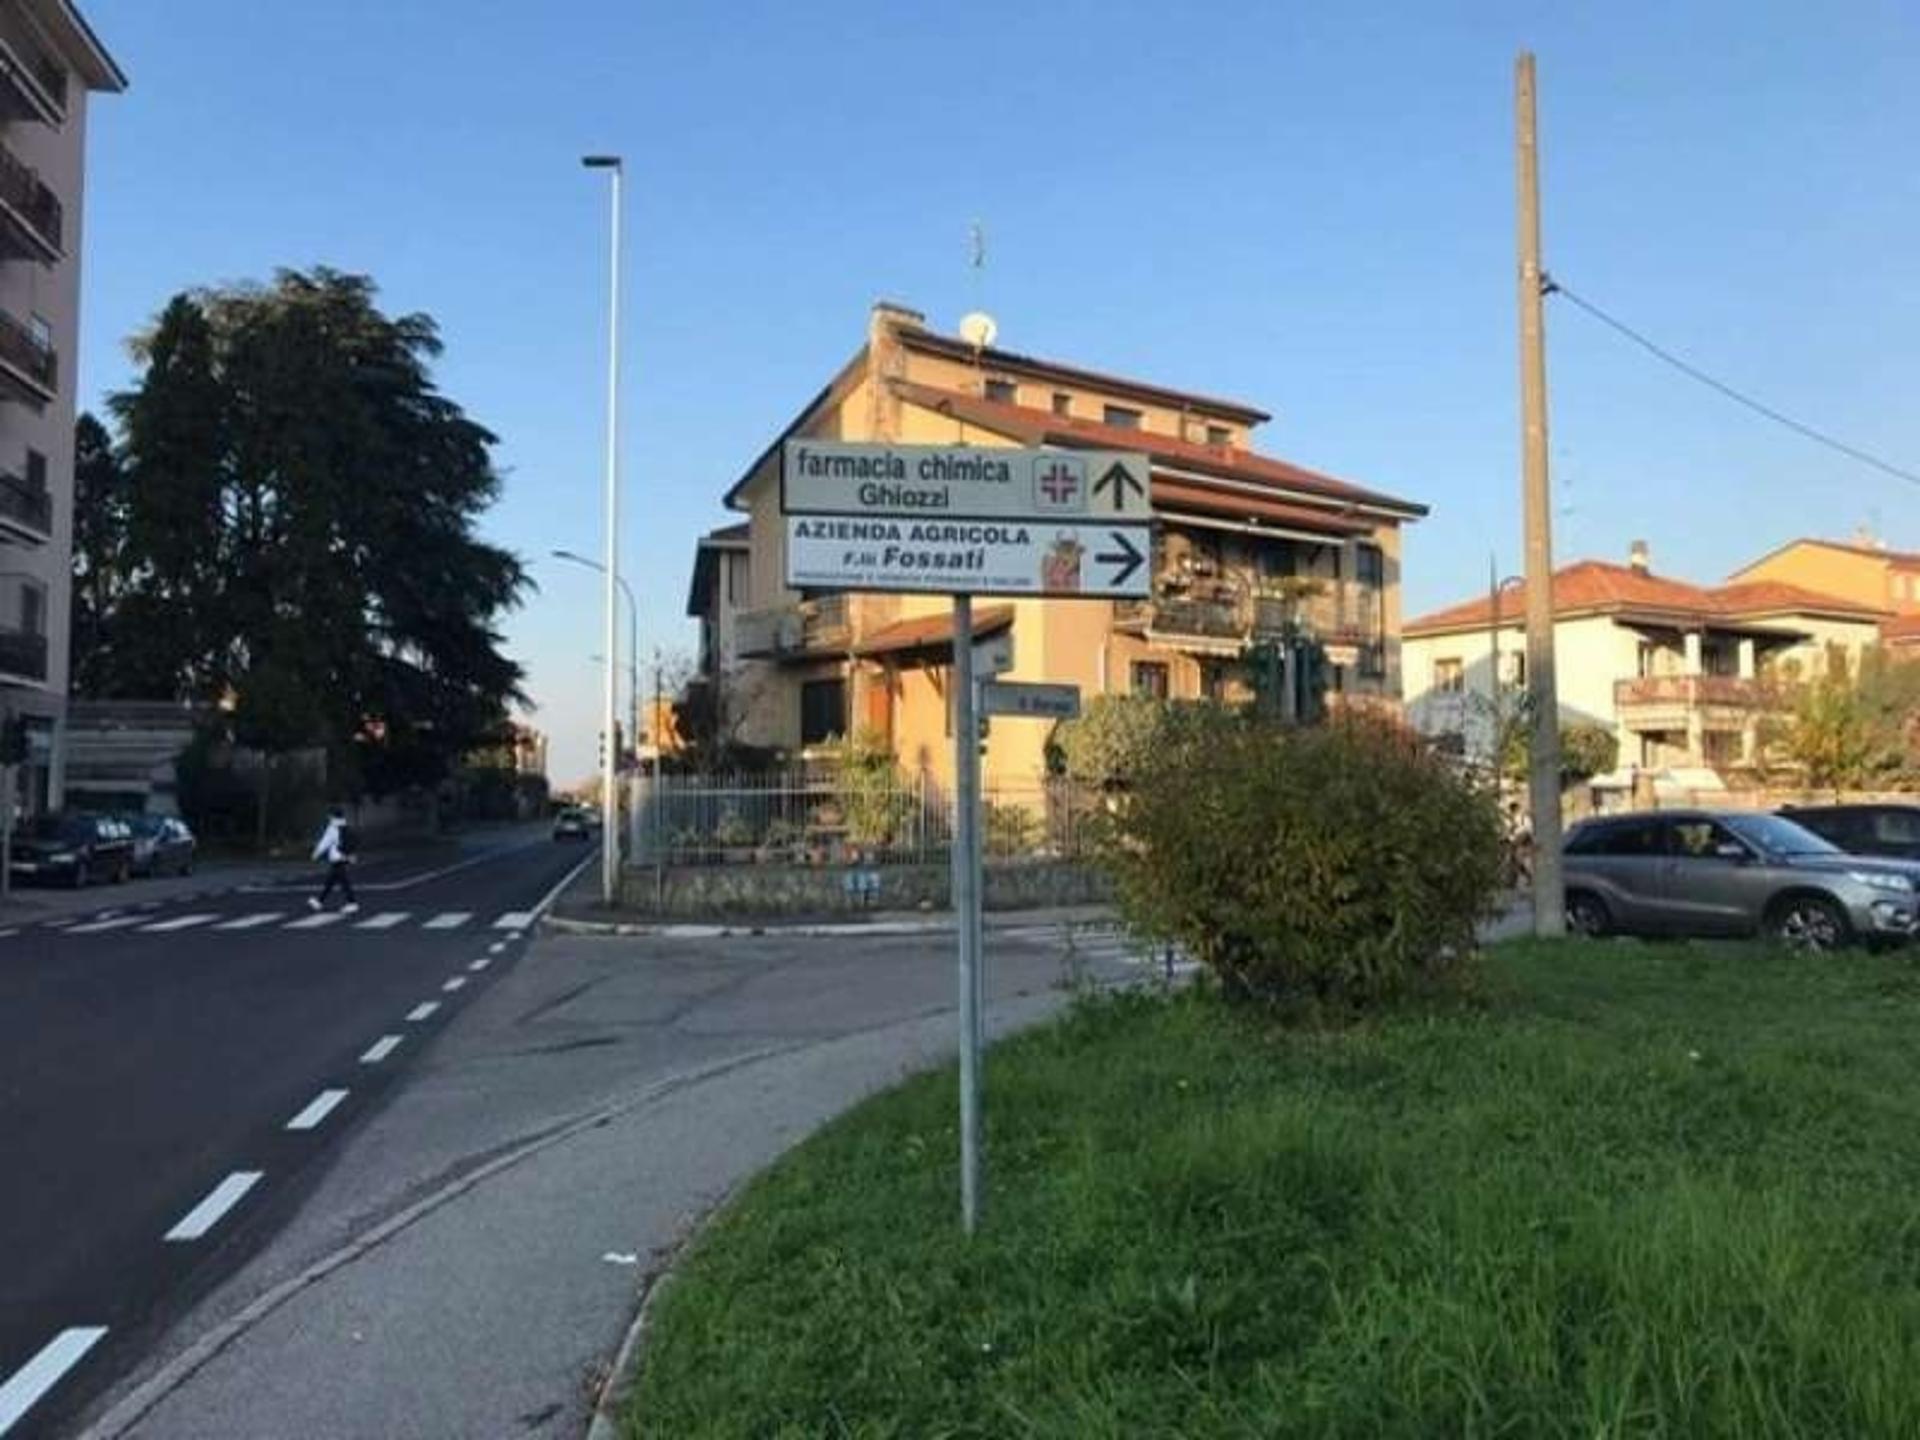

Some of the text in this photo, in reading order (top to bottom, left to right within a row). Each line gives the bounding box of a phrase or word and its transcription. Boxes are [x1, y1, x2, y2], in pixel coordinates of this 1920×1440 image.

[798, 449, 1010, 482] farmacia chimica
[859, 482, 949, 508] Ghiozzi
[795, 521, 1030, 545] AZIENDA AGRICOLA
[883, 547, 985, 569] Fossati
